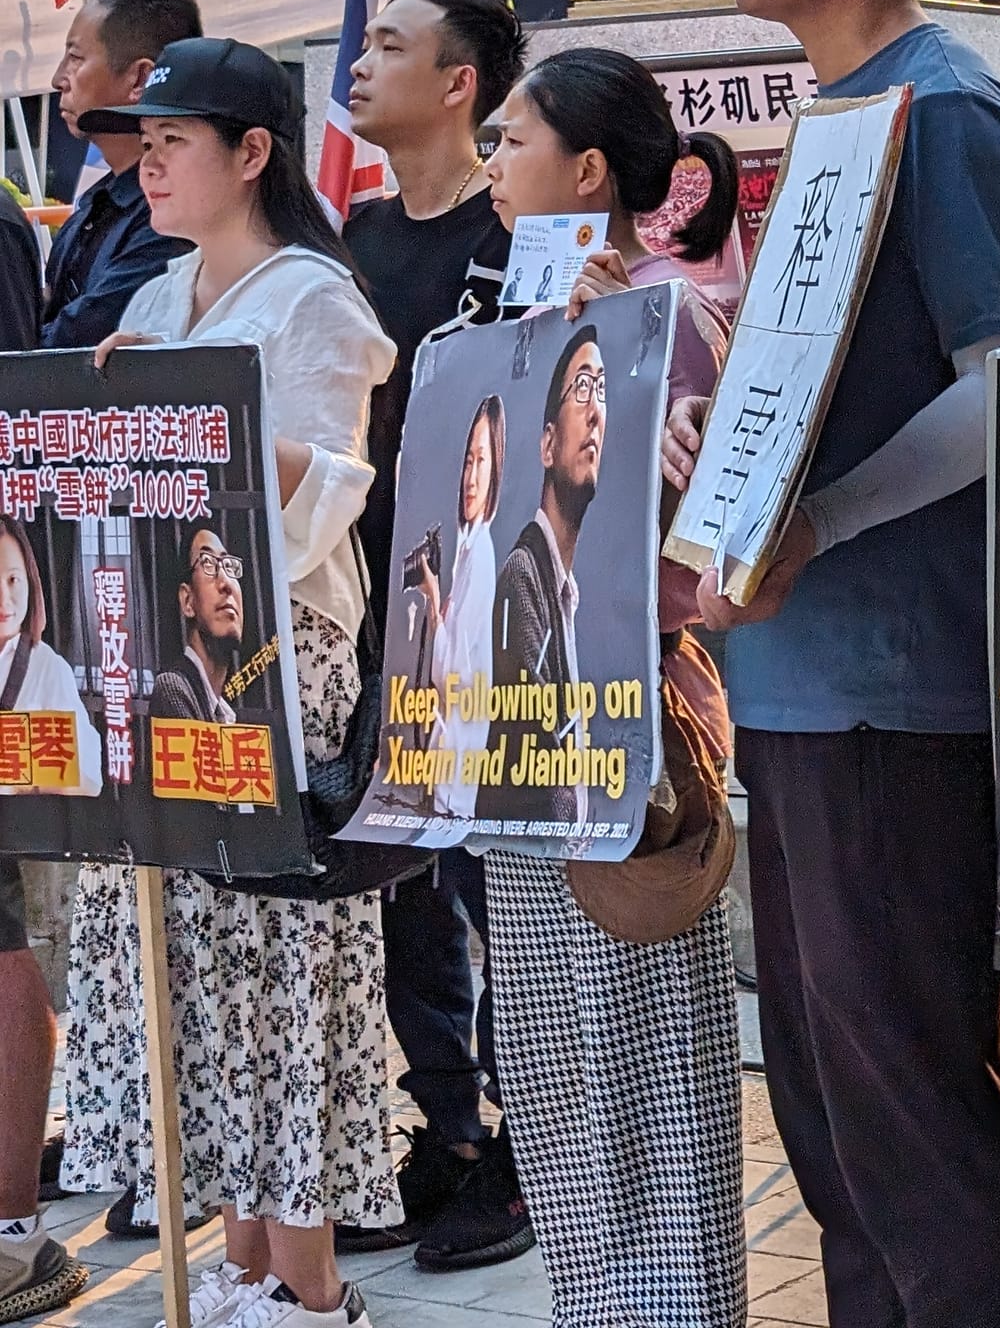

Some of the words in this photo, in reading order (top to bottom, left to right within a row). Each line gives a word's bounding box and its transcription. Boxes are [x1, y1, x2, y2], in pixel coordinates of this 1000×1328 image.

[93, 568, 133, 783] 釋放雪餅
[389, 675, 438, 733] Keep
[445, 669, 557, 732] Following
[565, 680, 597, 732] up
[604, 678, 642, 719] on
[153, 726, 272, 798] 王建兵
[382, 735, 455, 796] Xueqin
[463, 734, 507, 786] and
[511, 733, 626, 800] Jianbing
[525, 820, 570, 837] ARRESTED
